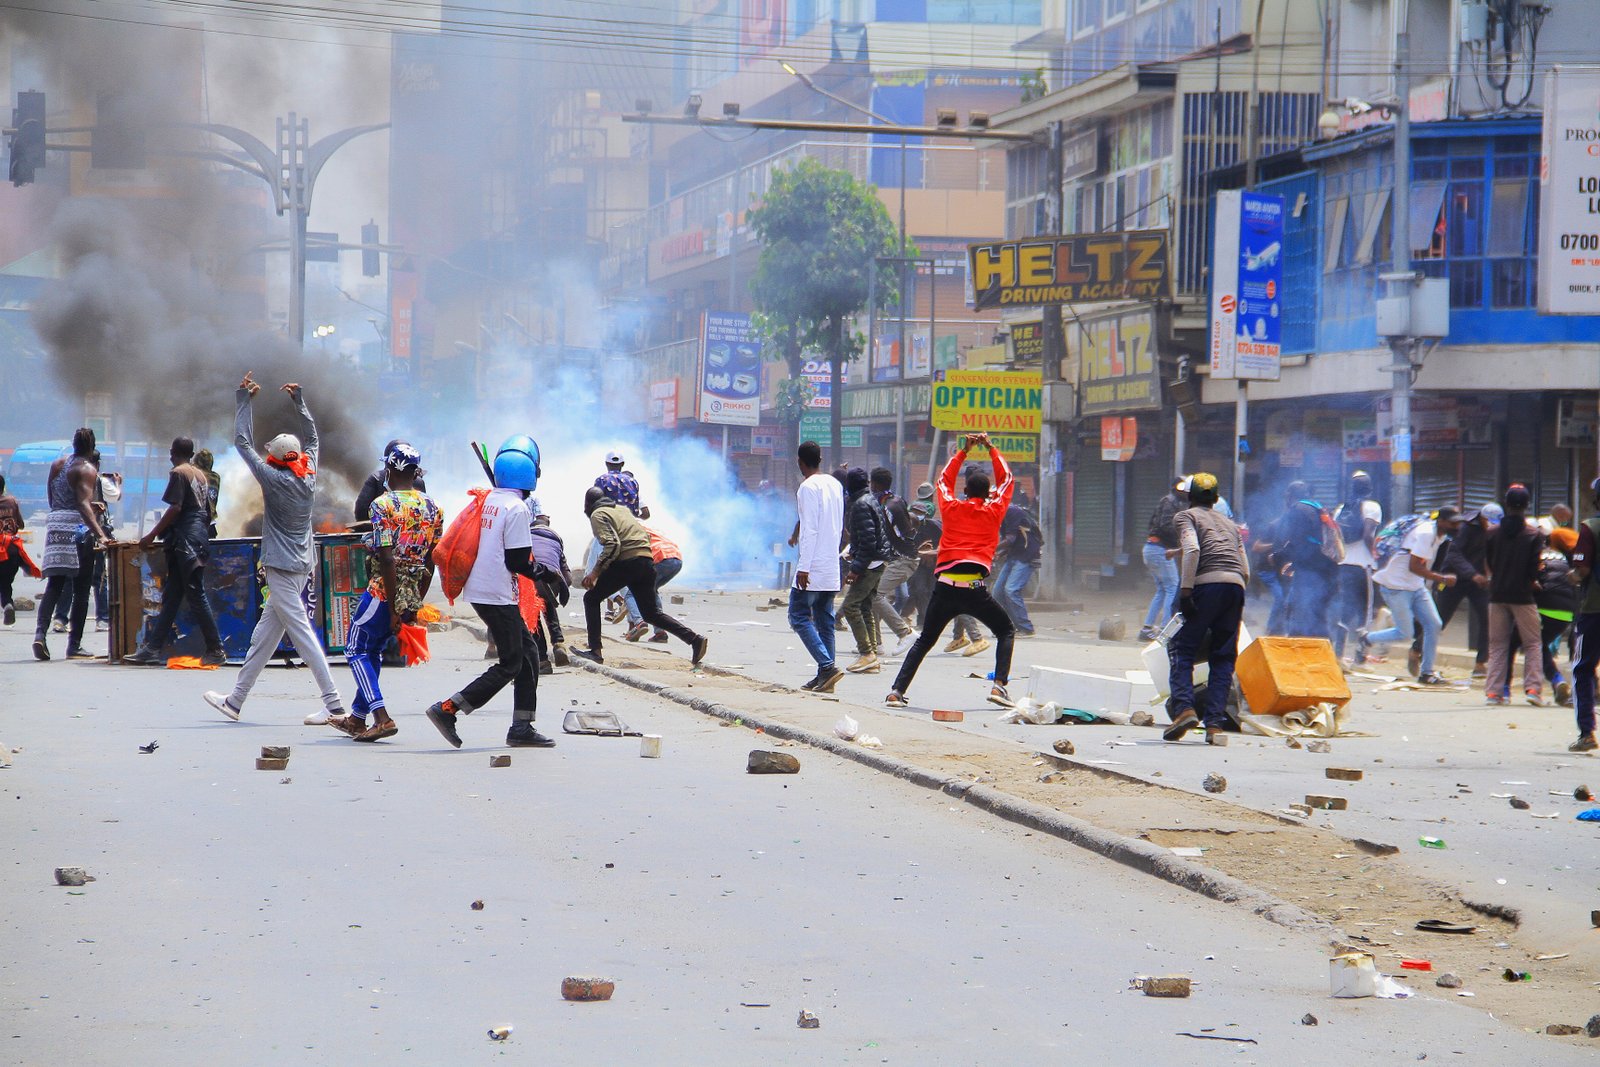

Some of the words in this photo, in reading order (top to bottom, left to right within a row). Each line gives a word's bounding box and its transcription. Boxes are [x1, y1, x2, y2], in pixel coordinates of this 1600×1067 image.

[1588, 144, 1600, 157] C
[1579, 177, 1600, 194] LO
[1561, 234, 1598, 250] 0700
[976, 239, 1162, 290] HELTZ
[1001, 286, 1073, 304] DRIVING
[1082, 313, 1153, 380] HELTZ
[950, 375, 1001, 385] SUNSENSOR
[723, 402, 751, 410] RIKKO
[961, 413, 1034, 430] MIWANI
[958, 437, 1034, 452] OCIANS
